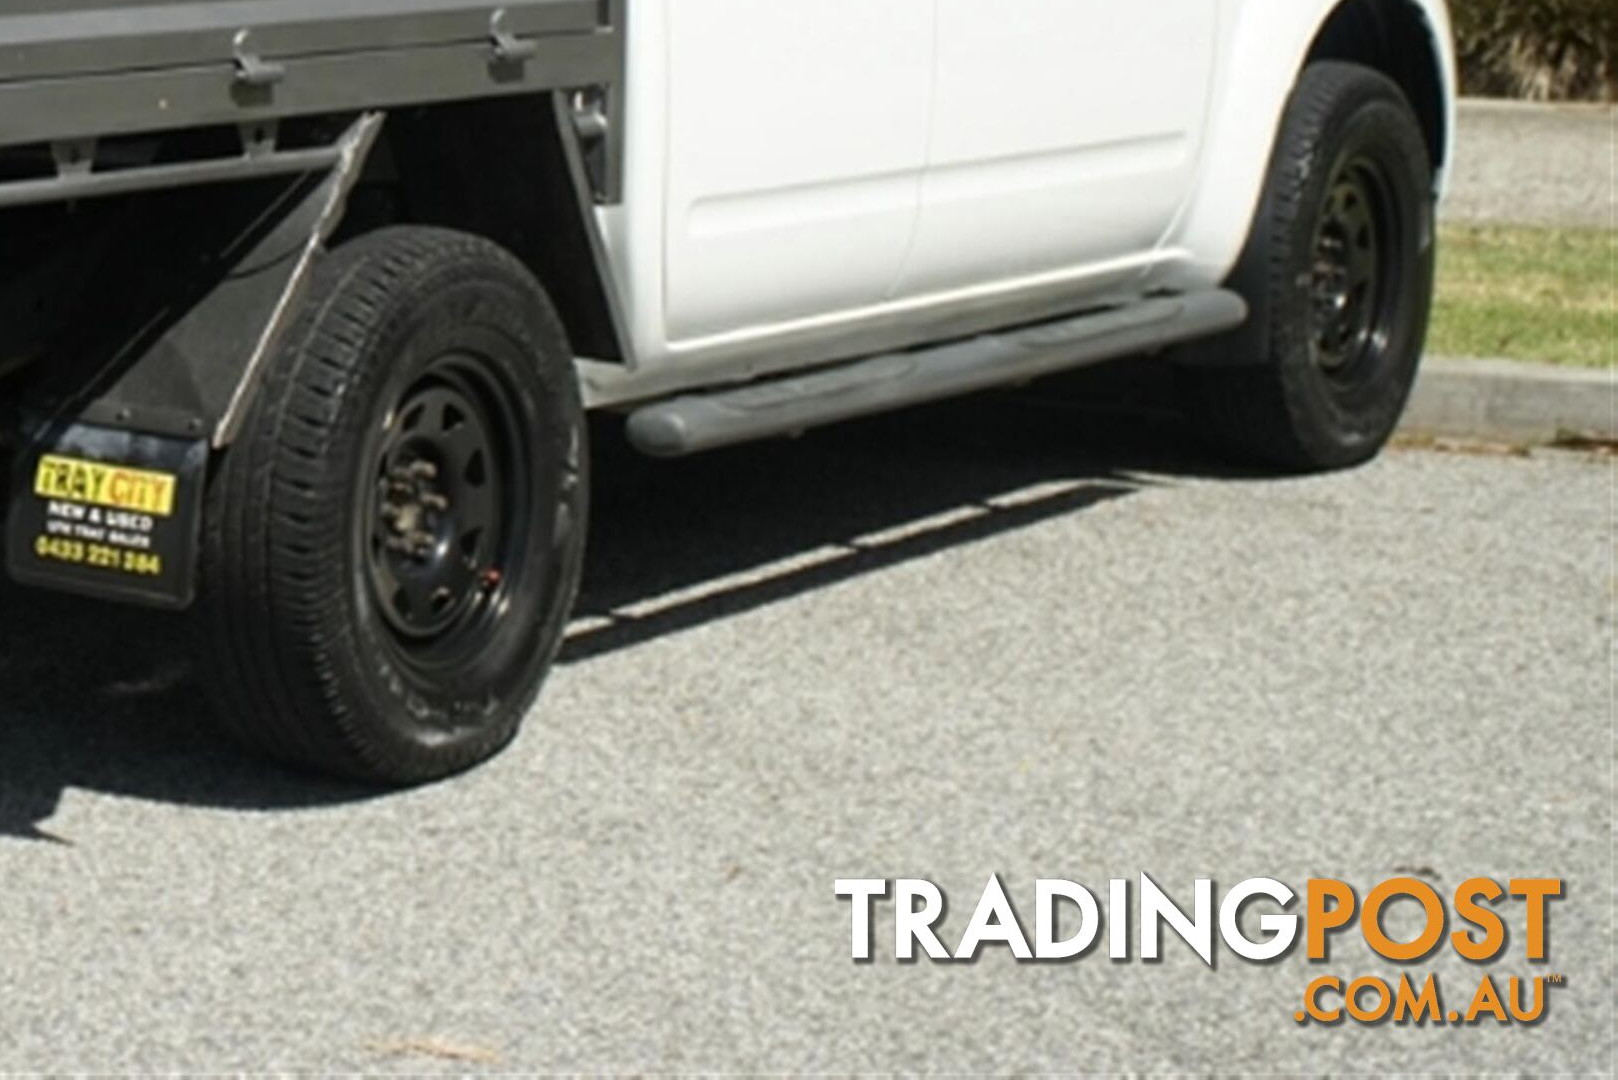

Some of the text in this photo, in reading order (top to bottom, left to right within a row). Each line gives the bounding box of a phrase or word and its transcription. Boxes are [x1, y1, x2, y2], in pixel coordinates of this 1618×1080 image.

[41, 461, 167, 508] TRAY CITY
[47, 500, 86, 520] NEW
[106, 510, 154, 531] USED
[35, 535, 84, 561] 0433
